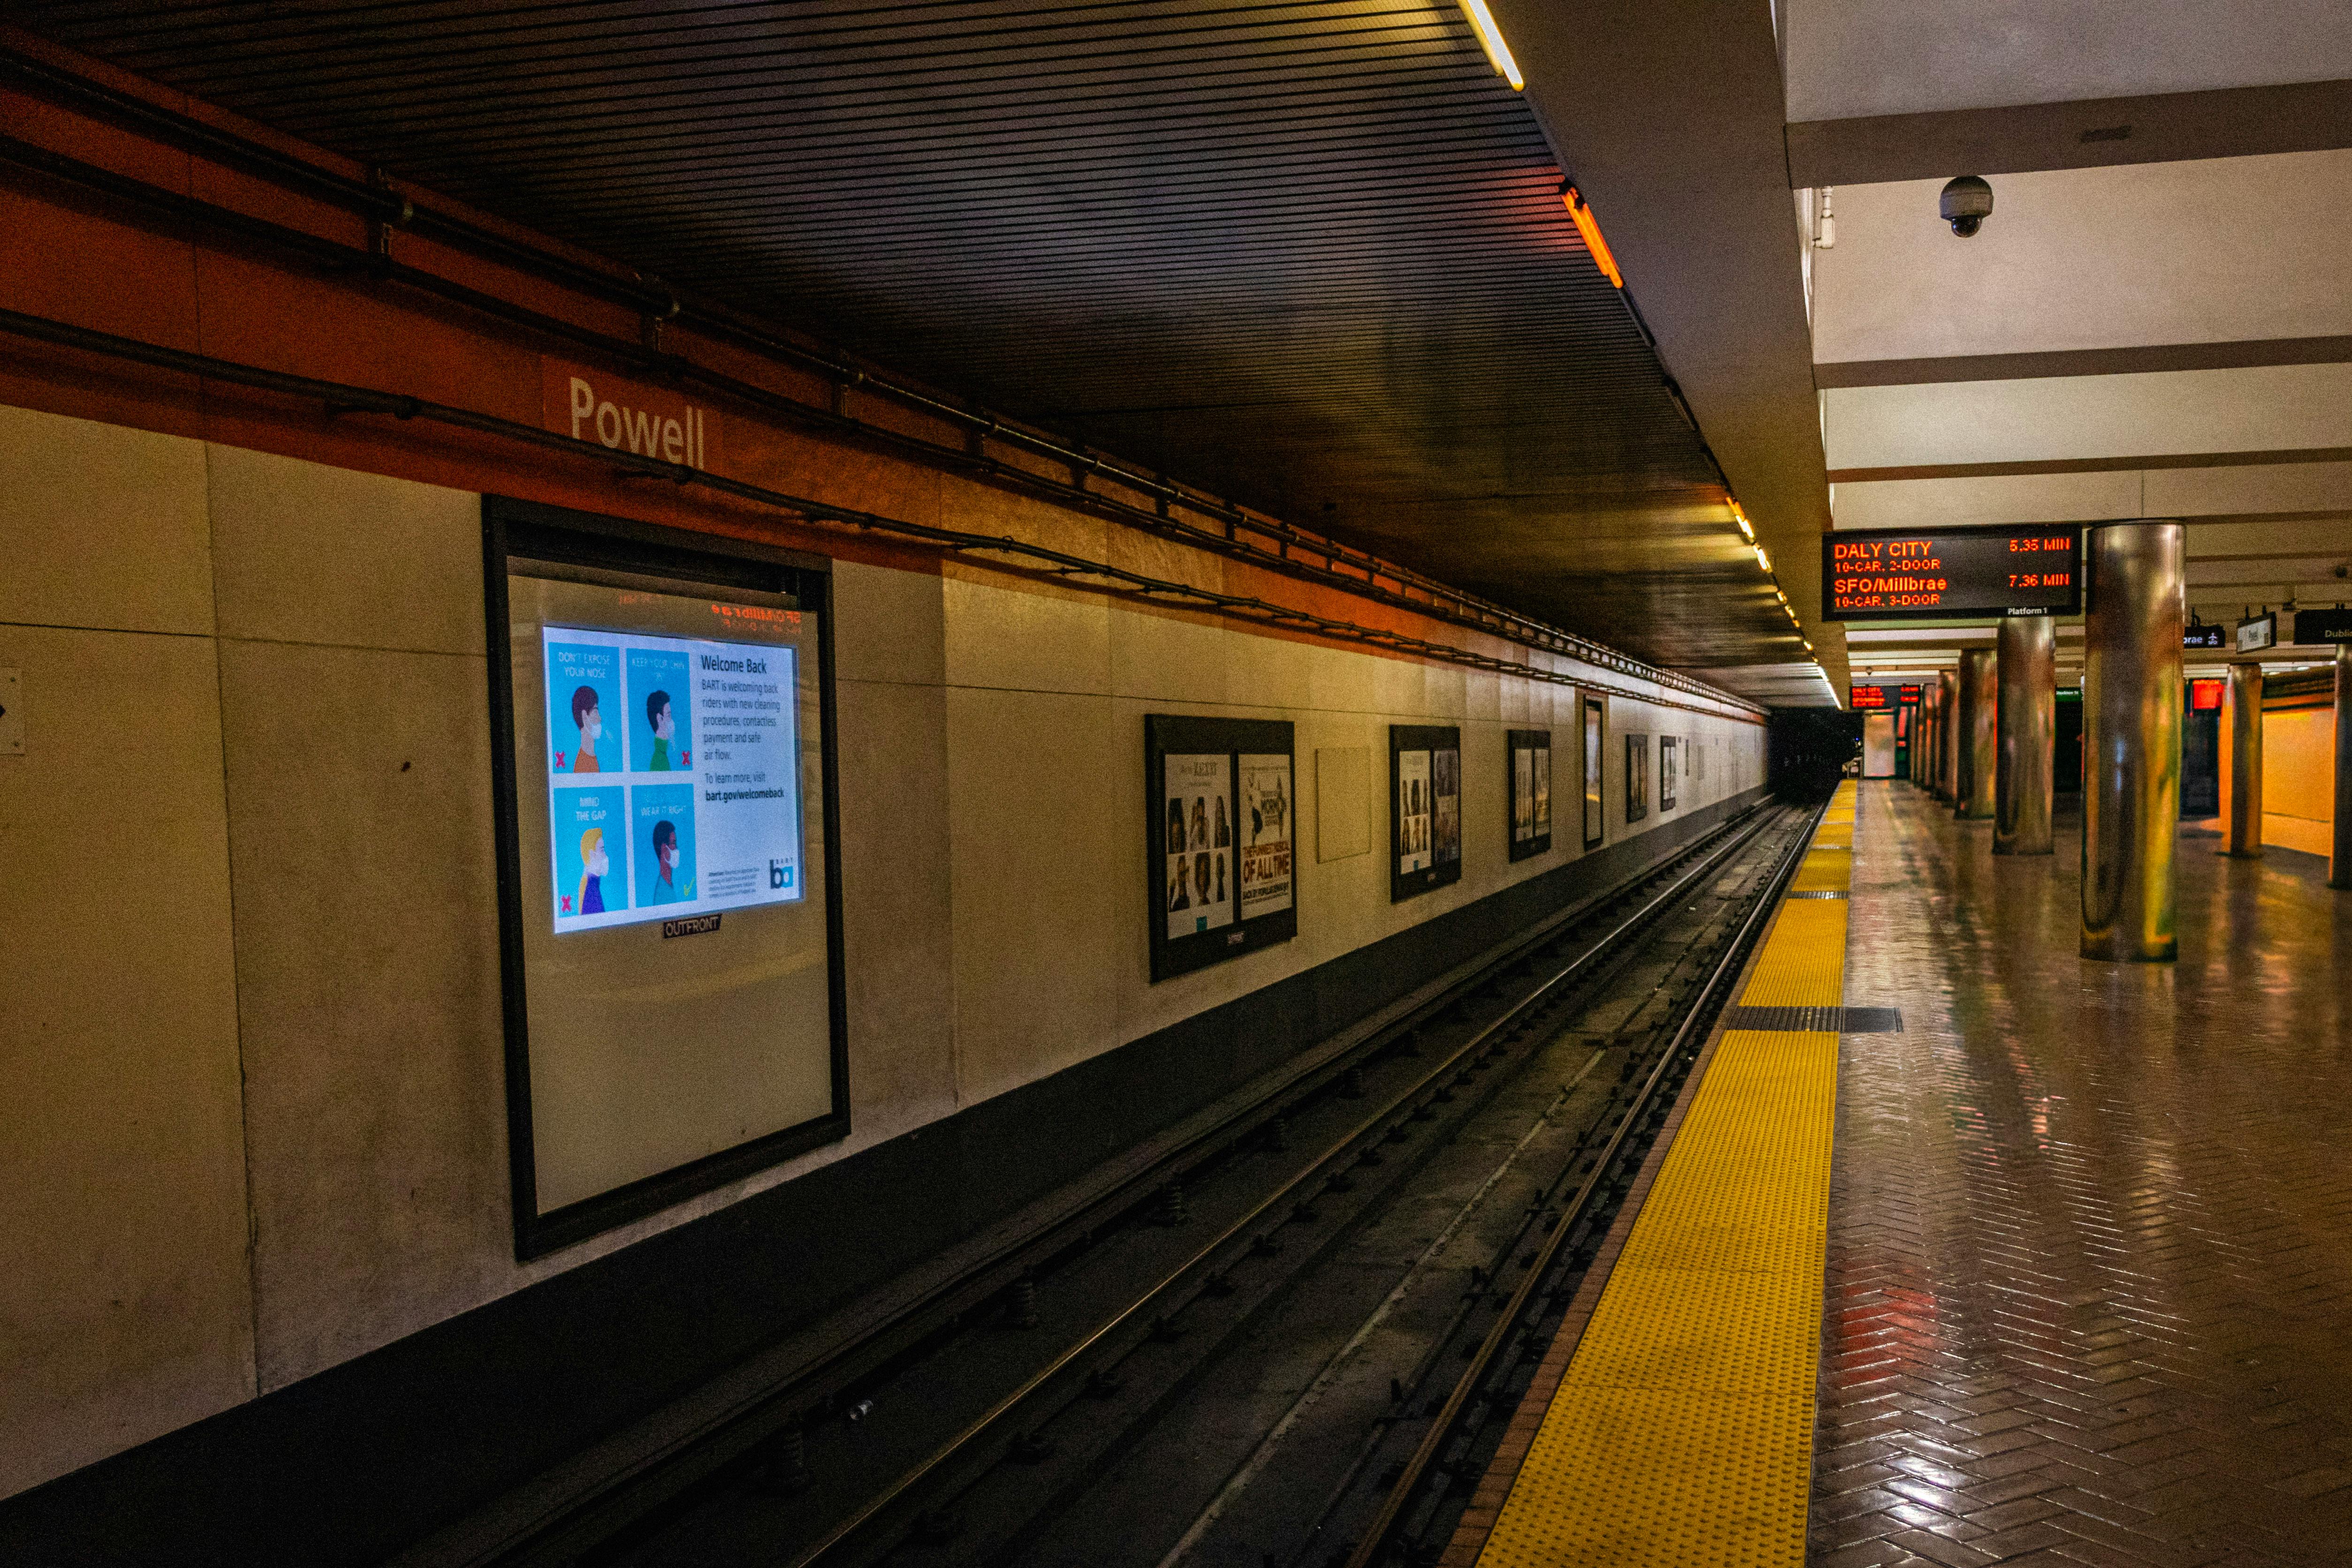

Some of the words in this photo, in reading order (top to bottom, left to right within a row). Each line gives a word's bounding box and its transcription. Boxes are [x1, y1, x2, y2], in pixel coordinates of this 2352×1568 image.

[570, 377, 704, 470] Powell
[1834, 543, 1883, 560] DALY
[1889, 541, 1933, 558] CITY
[2043, 538, 2071, 552] MIN
[1889, 559, 1941, 572] 2-DOOR
[1834, 577, 1948, 594] SFO/Millbrae
[2043, 573, 2070, 586] MIN
[1889, 593, 1940, 606] 3-DOOR
[2325, 629, 2352, 638] Dubli
[701, 654, 744, 673] Welcome
[746, 658, 766, 674] Back
[564, 666, 585, 677] YOUR
[587, 668, 606, 678] NOSE
[702, 679, 720, 690] BART
[721, 680, 727, 691] is
[728, 682, 762, 696] welcoming
[764, 682, 779, 694] back
[703, 697, 721, 708] riders
[723, 698, 738, 709] with
[754, 698, 780, 713] cleaning
[703, 715, 741, 728] procedures,
[743, 717, 777, 727] contactless
[704, 733, 732, 746] payment
[735, 733, 746, 743] and
[748, 732, 761, 743] safe
[704, 749, 713, 760] air
[715, 748, 732, 760] flow.
[705, 773, 713, 784] To
[715, 773, 732, 784] learn
[733, 774, 751, 784] more,
[753, 771, 766, 782] visit
[706, 787, 784, 803] bart.gov/welcomeback
[576, 811, 589, 821] THE
[591, 810, 607, 820] GAP
[1243, 859, 1255, 883] OF
[1256, 856, 1273, 881] ALL
[666, 916, 719, 937] OUTFRONT
